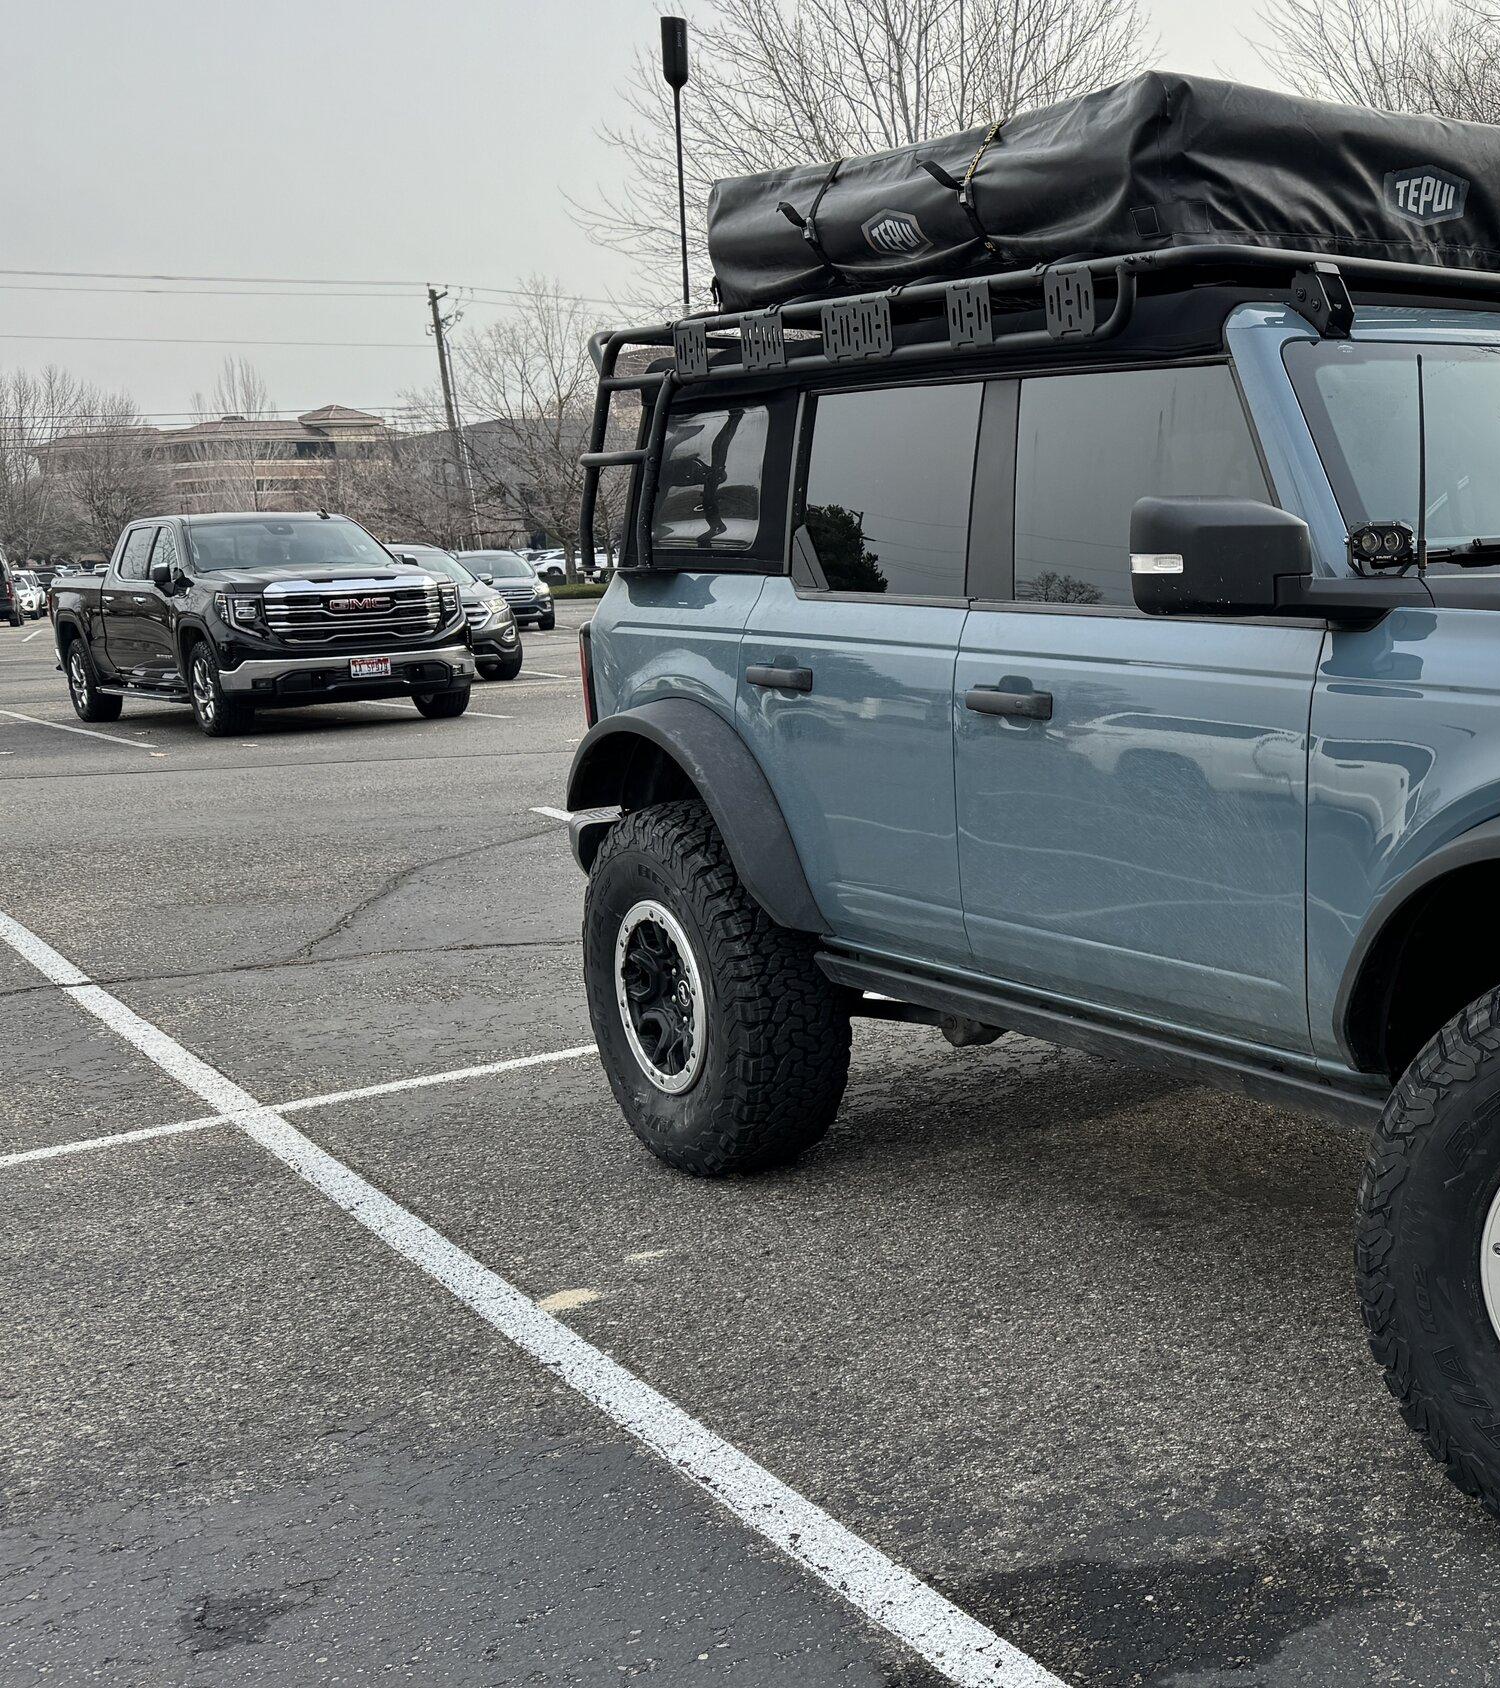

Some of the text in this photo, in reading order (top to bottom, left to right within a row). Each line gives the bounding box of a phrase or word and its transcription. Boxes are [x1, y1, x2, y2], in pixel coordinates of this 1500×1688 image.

[1396, 176, 1455, 215] TEPUI
[871, 219, 920, 251] TEPUI
[329, 597, 391, 610] GMC
